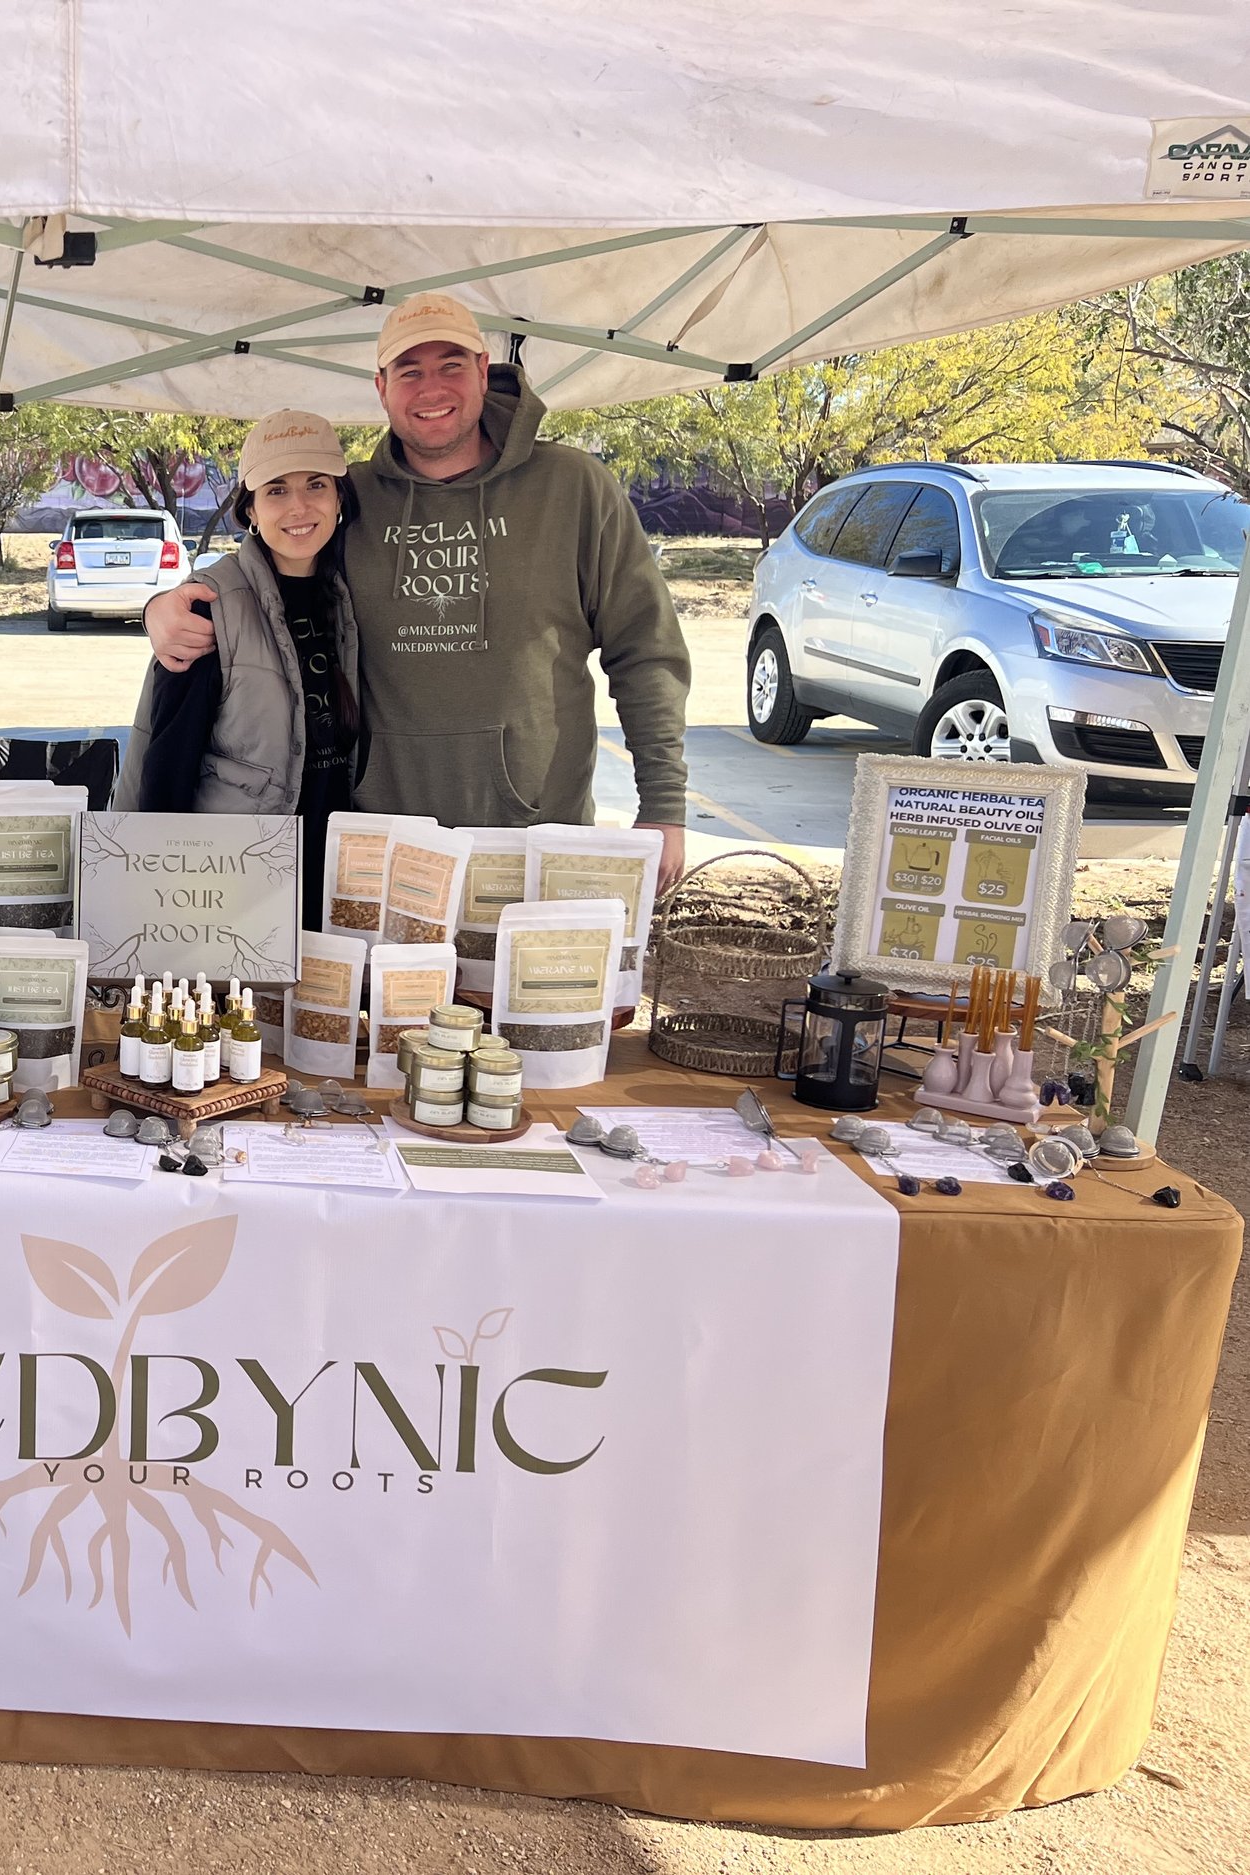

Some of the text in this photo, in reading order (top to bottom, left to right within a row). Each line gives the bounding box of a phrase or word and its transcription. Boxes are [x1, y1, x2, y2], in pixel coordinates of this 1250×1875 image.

[383, 517, 508, 545] RECLAM
[408, 545, 479, 569] YOUR
[899, 787, 959, 800] ORGANIC
[962, 792, 1015, 806] HERBAL
[894, 799, 956, 813] NATURAL
[959, 805, 1012, 818] BEAUTY
[890, 811, 924, 823] HERB
[926, 815, 981, 828] INFUSED
[984, 820, 1021, 832] OLIVE
[893, 827, 954, 839] LOOSE LEAF TEA
[980, 834, 1022, 844] FACIAL OILS
[18, 850, 32, 859] BE
[35, 849, 55, 858] TEA
[125, 853, 246, 875] RECLAIM
[921, 876, 942, 886] $20
[978, 882, 1005, 896] $25
[154, 888, 224, 909] YOUR
[895, 903, 930, 913] OLIVE OIL
[955, 909, 979, 918] HERBAL
[143, 922, 233, 944] ROOTS
[42, 986, 60, 994] TEA
[42, 1461, 190, 1487] YOUR
[245, 1470, 435, 1494] ROOTS
